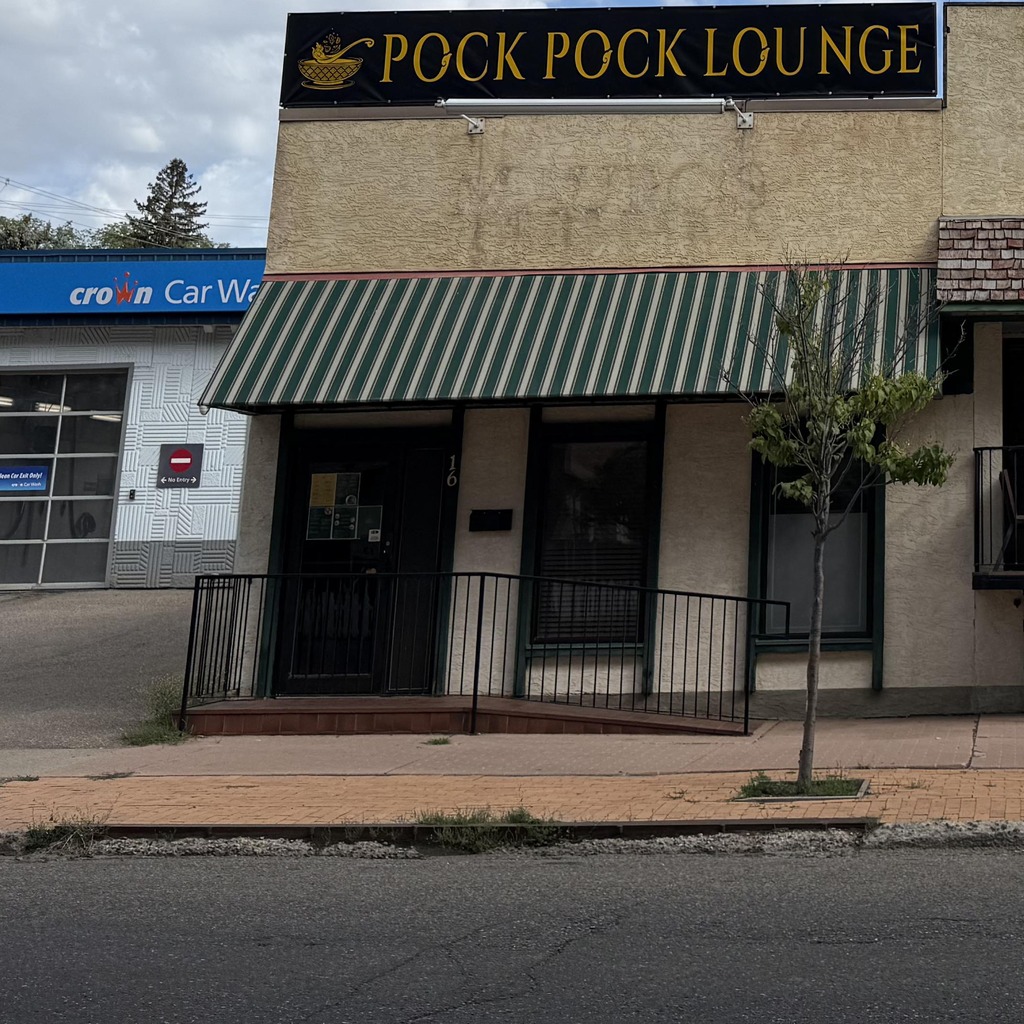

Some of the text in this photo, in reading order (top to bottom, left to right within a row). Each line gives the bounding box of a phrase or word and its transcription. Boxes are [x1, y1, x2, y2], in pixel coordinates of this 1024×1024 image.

[379, 24, 922, 83] POCK POCK LOUNGE
[69, 279, 153, 305] crown
[164, 279, 213, 305] Car
[446, 454, 458, 487] 16
